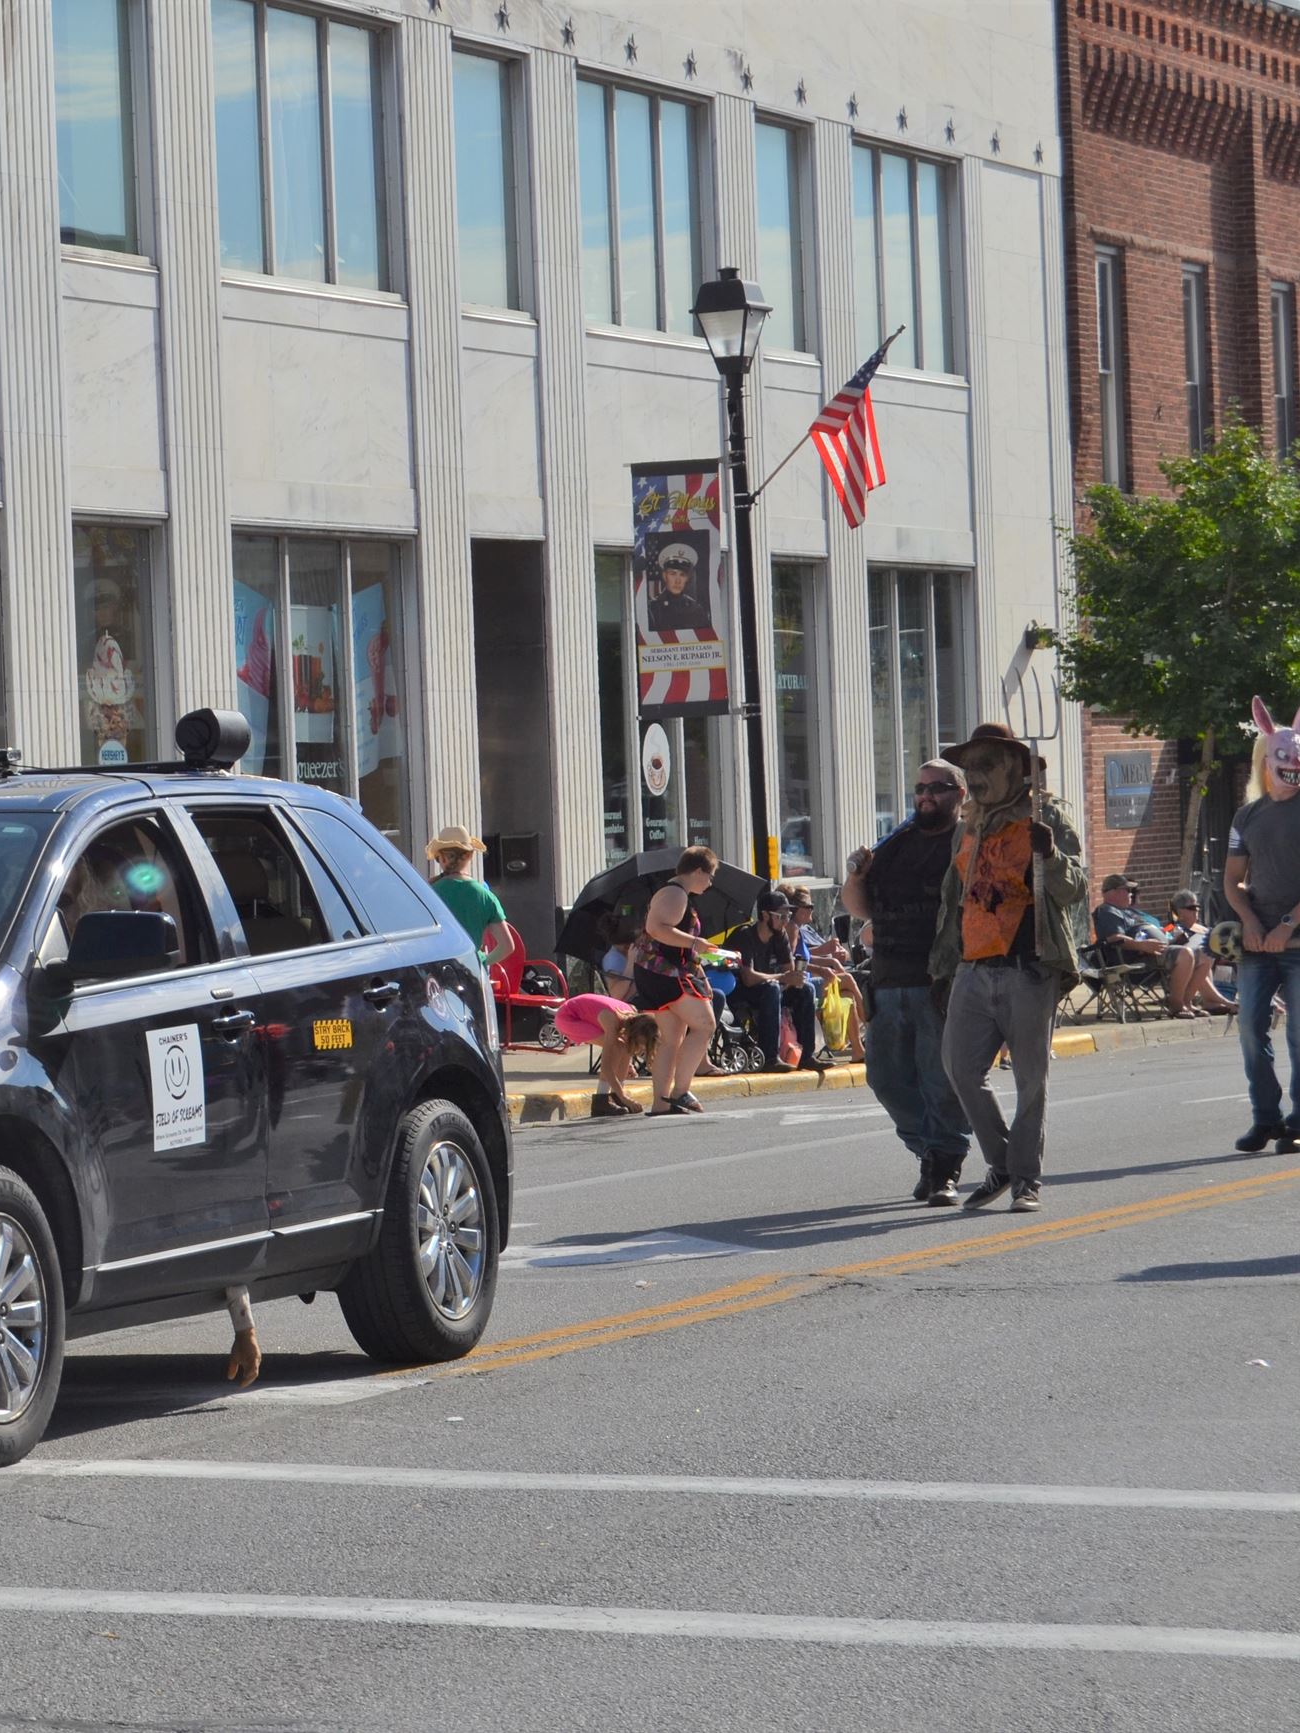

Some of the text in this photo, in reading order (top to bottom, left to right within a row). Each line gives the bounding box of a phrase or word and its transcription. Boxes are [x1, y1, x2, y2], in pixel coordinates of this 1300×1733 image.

[642, 653, 672, 662] NELSON
[680, 651, 710, 660] RUPARD
[298, 758, 348, 779] queezer's
[314, 1024, 350, 1035] STAY BACK
[158, 1032, 189, 1046] CHAINER'S
[320, 1034, 346, 1044] 50 FEET
